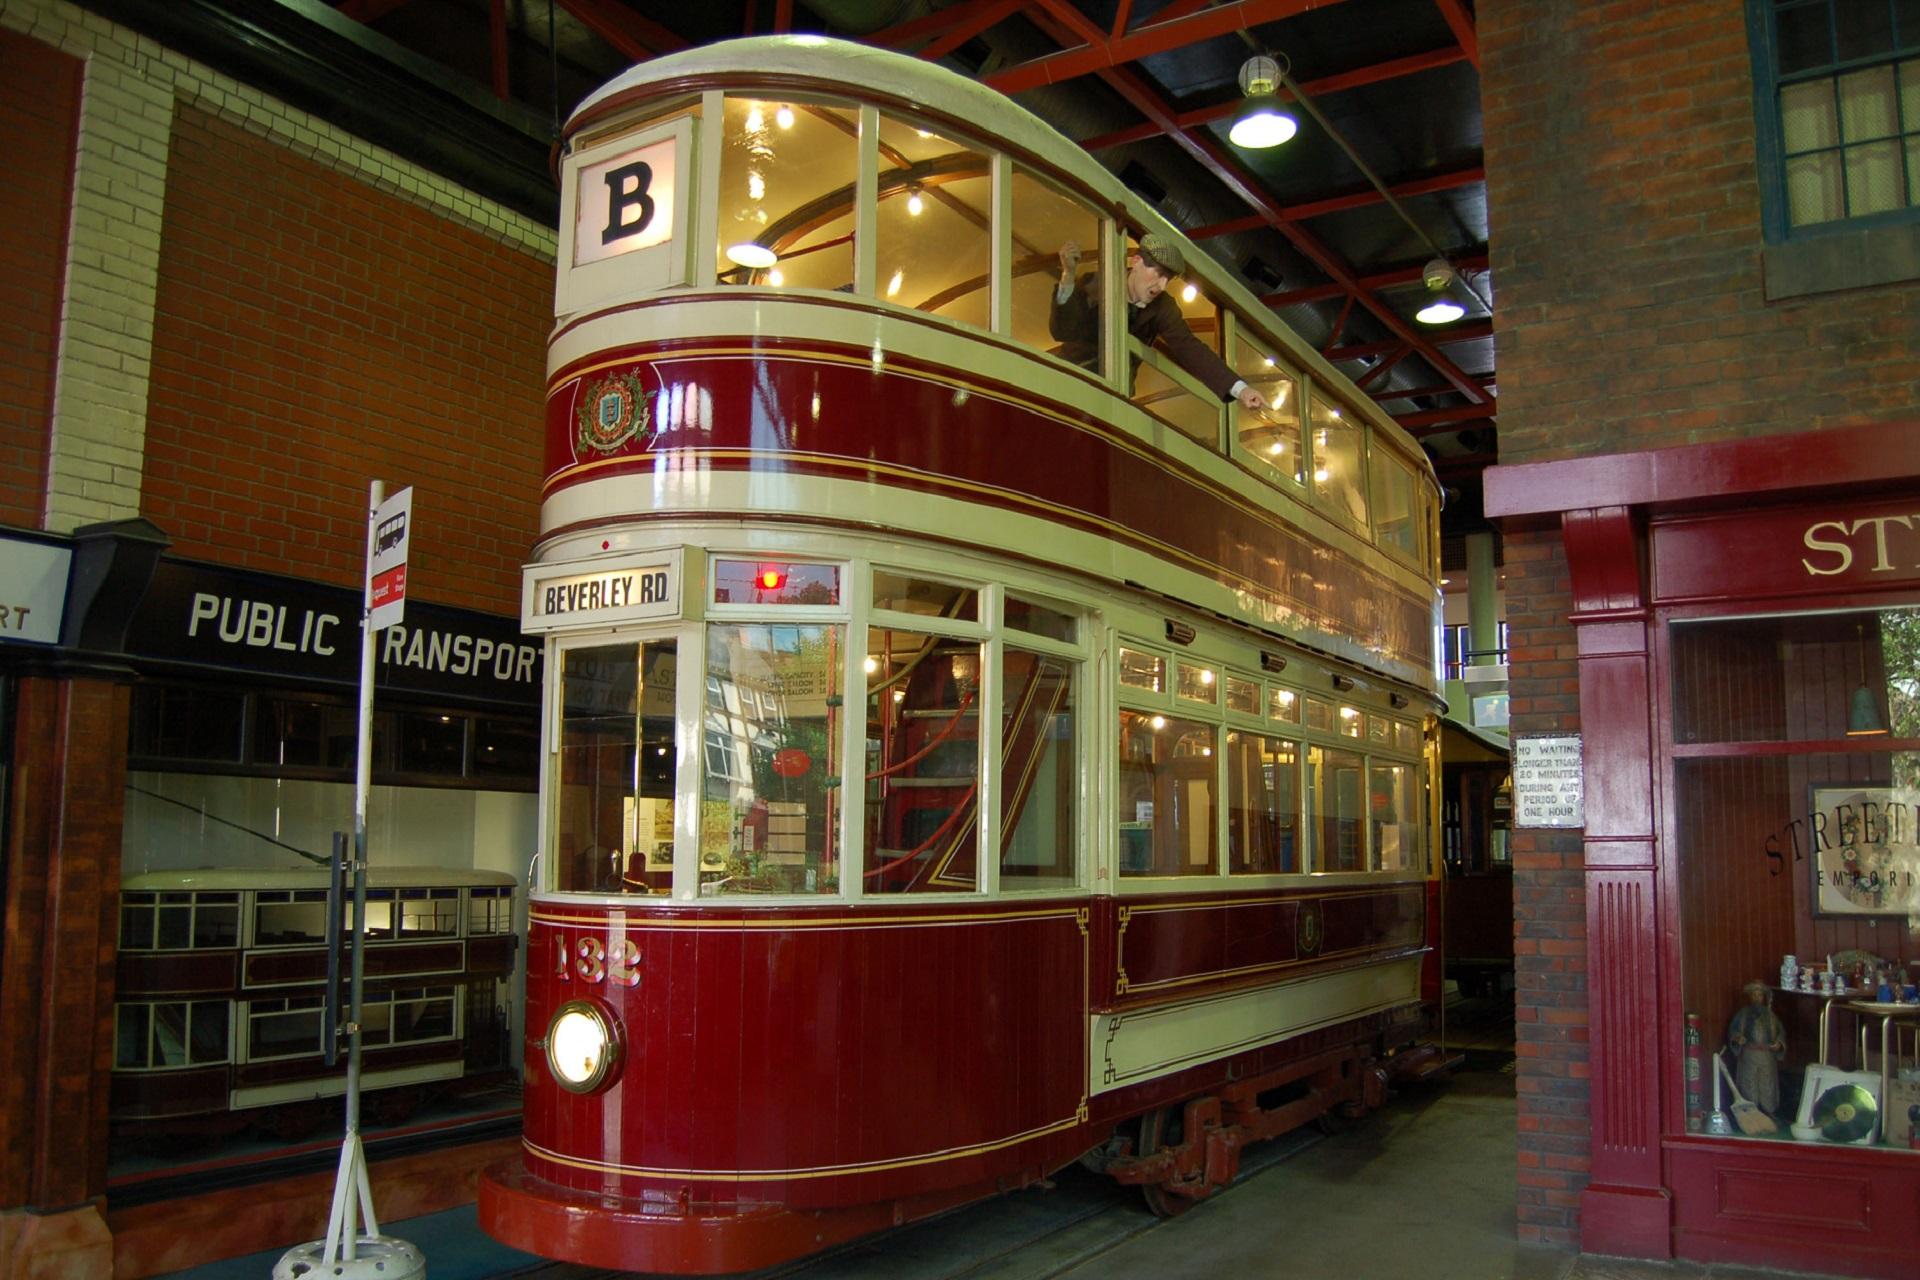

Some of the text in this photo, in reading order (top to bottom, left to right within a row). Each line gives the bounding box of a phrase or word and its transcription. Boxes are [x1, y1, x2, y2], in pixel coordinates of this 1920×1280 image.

[602, 161, 655, 246] B
[1802, 514, 1920, 575] ST
[545, 576, 632, 615] BEVERLEY
[188, 592, 545, 683] PUBLIC RANSPOR
[1519, 746, 1531, 756] NO
[1519, 760, 1552, 768] LONGER
[1538, 770, 1579, 778] MINUTES
[1519, 784, 1553, 793] DURING
[1523, 795, 1557, 804] PERIOD
[1524, 808, 1574, 817] ONE HOUR
[556, 935, 642, 987] 132
